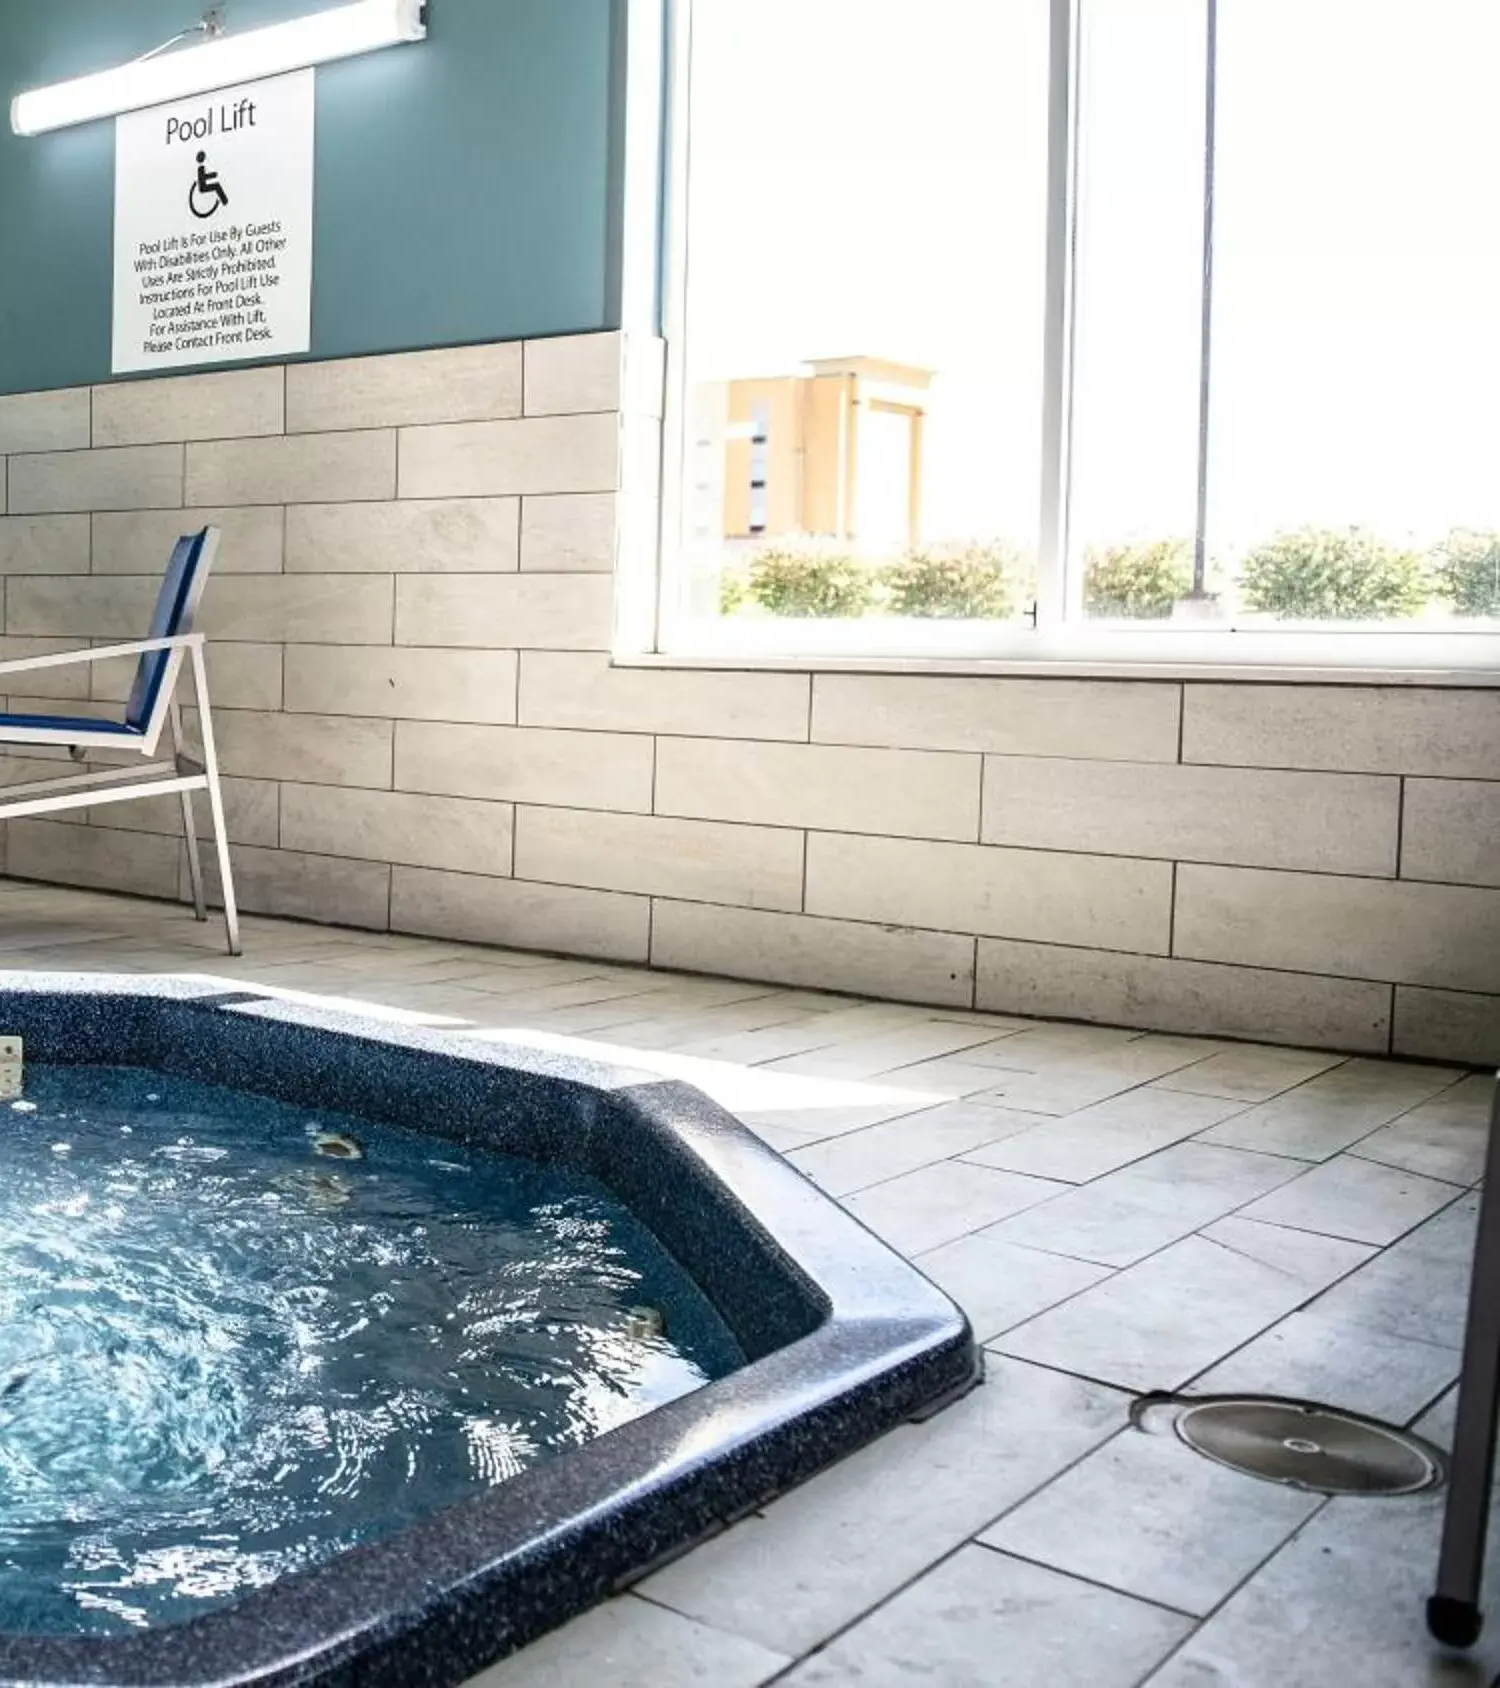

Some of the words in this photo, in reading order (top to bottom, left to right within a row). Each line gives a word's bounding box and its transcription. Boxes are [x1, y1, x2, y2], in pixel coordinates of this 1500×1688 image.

[166, 107, 213, 145] Pool
[221, 98, 257, 132] Lift
[139, 240, 161, 255] Pool
[163, 237, 179, 252] Lift
[190, 233, 207, 247] For
[209, 230, 228, 243] Use
[230, 225, 242, 241] By
[245, 221, 281, 237] Guests
[134, 258, 157, 272] With
[158, 251, 210, 269] Disabilities
[240, 242, 253, 255] All
[255, 237, 287, 253] Other
[139, 288, 195, 305] Instructions
[197, 284, 213, 296] For
[215, 278, 239, 294] Pool
[241, 276, 257, 291] Lift
[260, 274, 280, 287] Use
[142, 275, 164, 288] Uses
[166, 272, 183, 285] Are
[185, 265, 218, 282] Strictly
[153, 302, 191, 320] Located
[194, 301, 205, 313] At
[207, 298, 233, 312] Front
[149, 323, 165, 336] For
[167, 318, 218, 334] Assistance
[220, 312, 245, 327] With
[143, 340, 173, 353] Please
[175, 335, 213, 350] Contact
[215, 331, 242, 346] Front
